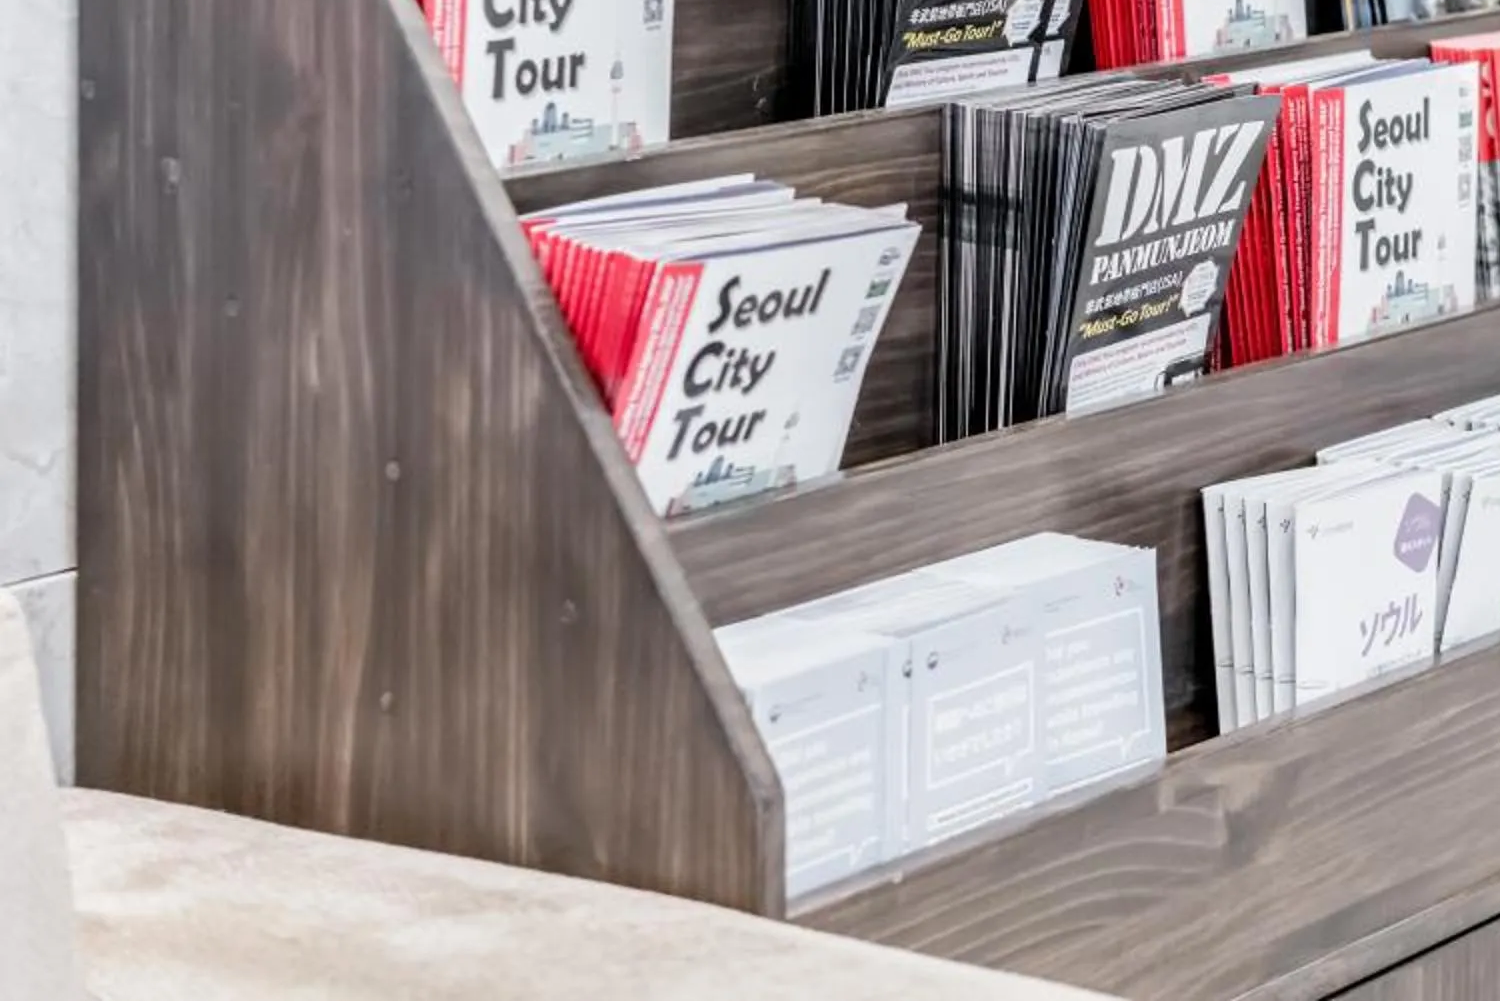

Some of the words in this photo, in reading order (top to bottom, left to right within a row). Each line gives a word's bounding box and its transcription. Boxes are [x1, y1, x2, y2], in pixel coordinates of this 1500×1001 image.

[486, 37, 586, 100] Tour
[1358, 97, 1430, 154] Seoul
[1094, 120, 1265, 248] DMZ
[1353, 159, 1414, 215] City
[1089, 219, 1236, 286] PANMUNJEOM
[1355, 218, 1422, 272] Tour
[707, 267, 832, 334] Seoul
[683, 340, 777, 398] City
[666, 404, 767, 461] Tour
[1360, 593, 1423, 657] ソウル
